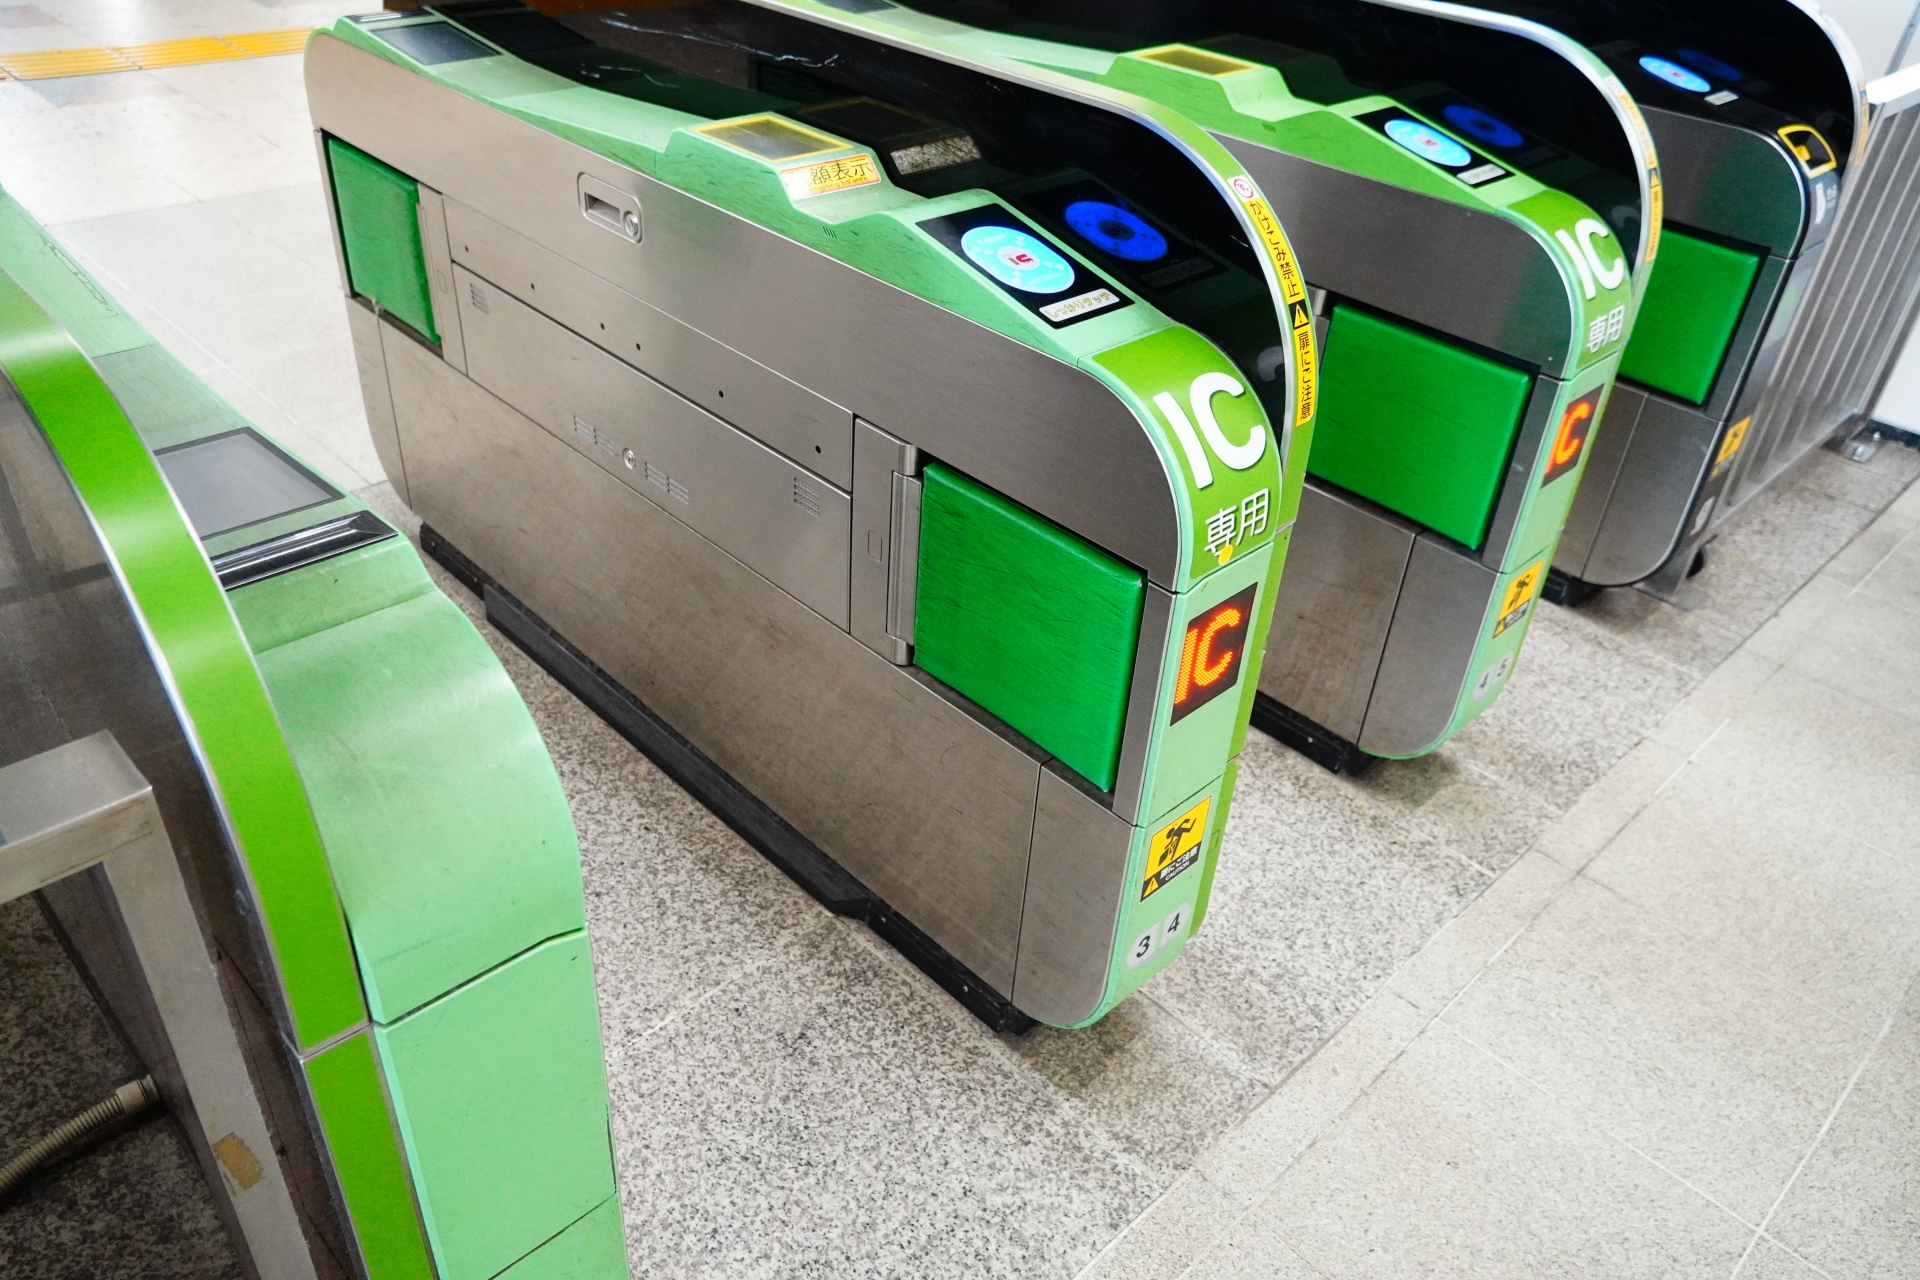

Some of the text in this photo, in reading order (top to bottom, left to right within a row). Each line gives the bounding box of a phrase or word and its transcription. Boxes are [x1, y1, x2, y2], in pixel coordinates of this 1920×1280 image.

[786, 158, 874, 187] 額表示
[841, 176, 869, 187] balance
[1249, 201, 1301, 298] かけこみ禁止
[1554, 217, 1625, 301] IC
[1045, 291, 1110, 319] しっかりタッチ
[1586, 304, 1625, 354] 専用
[1297, 330, 1313, 421] 扉にご注意
[1153, 371, 1267, 490] IC
[1203, 487, 1270, 556] 専用
[1173, 606, 1242, 705] IC
[1165, 861, 1190, 881] CAUTION
[1136, 912, 1180, 959] 3 4
